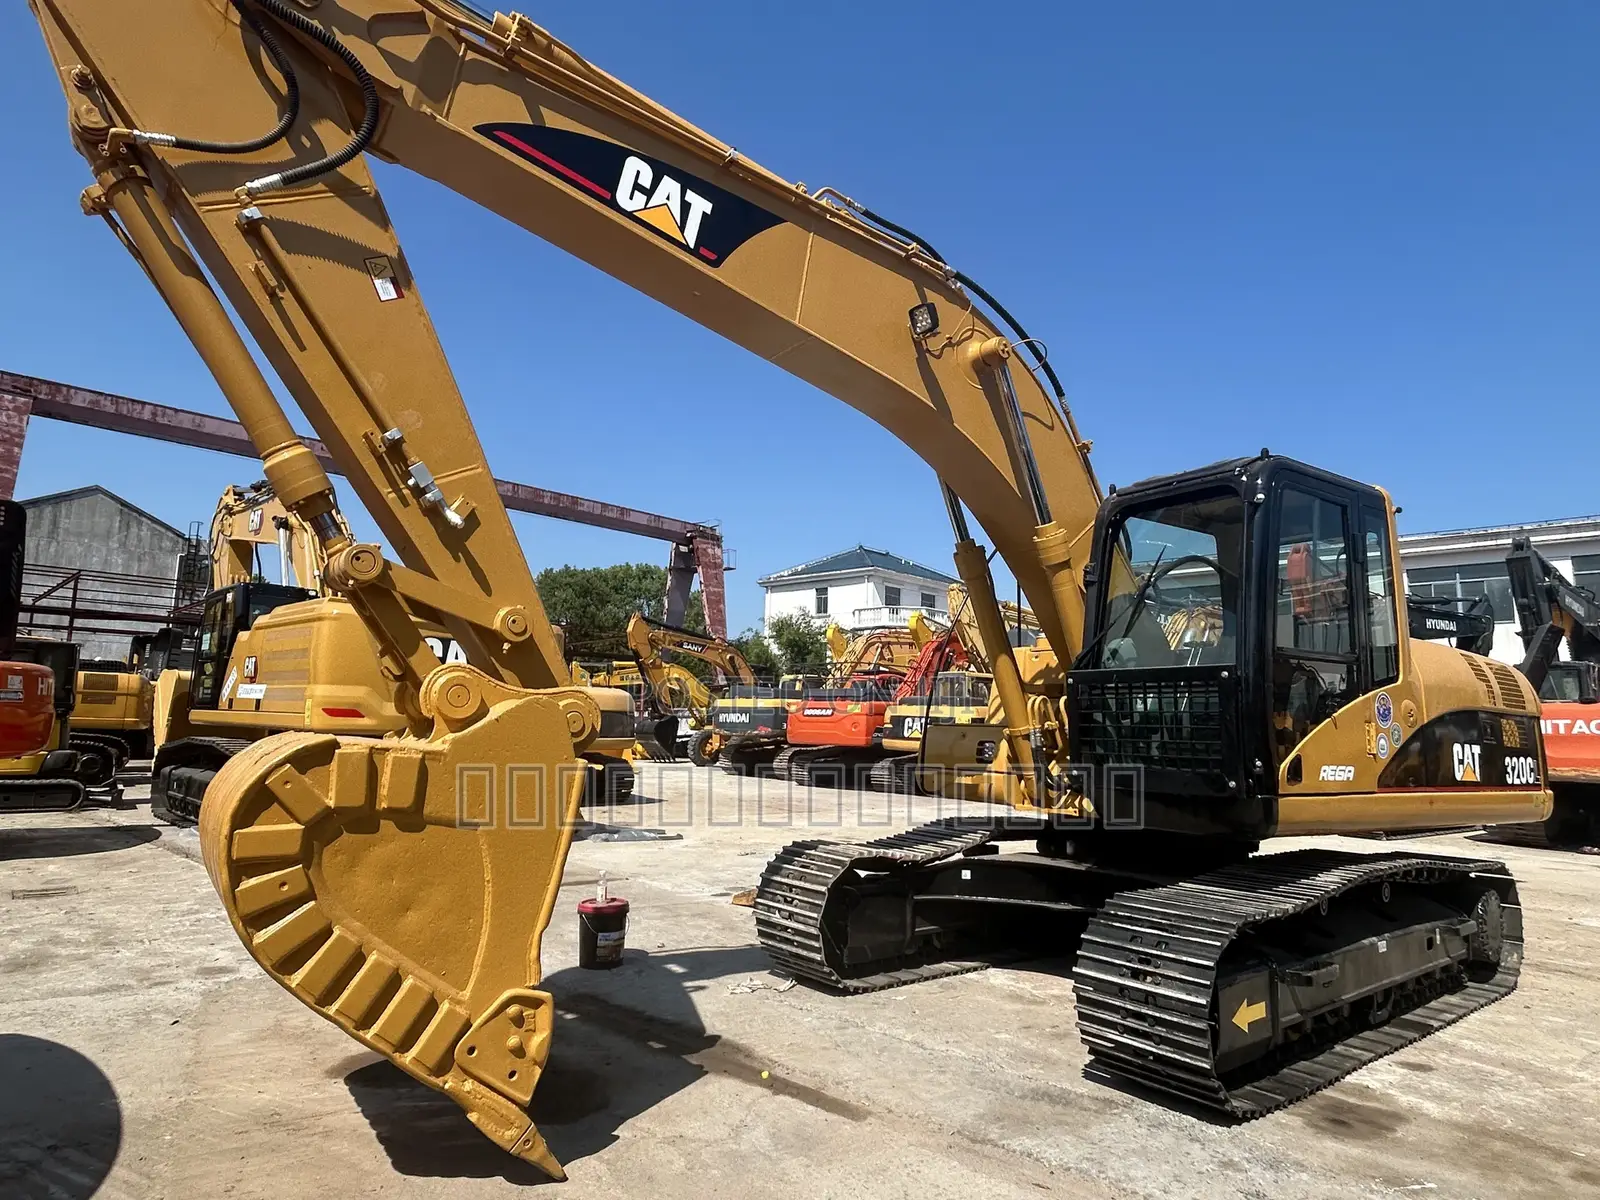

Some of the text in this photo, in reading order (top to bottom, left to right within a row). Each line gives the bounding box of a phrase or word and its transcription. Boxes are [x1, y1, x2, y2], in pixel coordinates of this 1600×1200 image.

[615, 155, 714, 249] CAT
[248, 509, 262, 532] CAT
[1425, 618, 1457, 632] HYUNDAI
[682, 642, 703, 653] SANY
[244, 656, 257, 678] CAT
[719, 713, 750, 724] HYUNDAI
[1452, 743, 1482, 782] CAT
